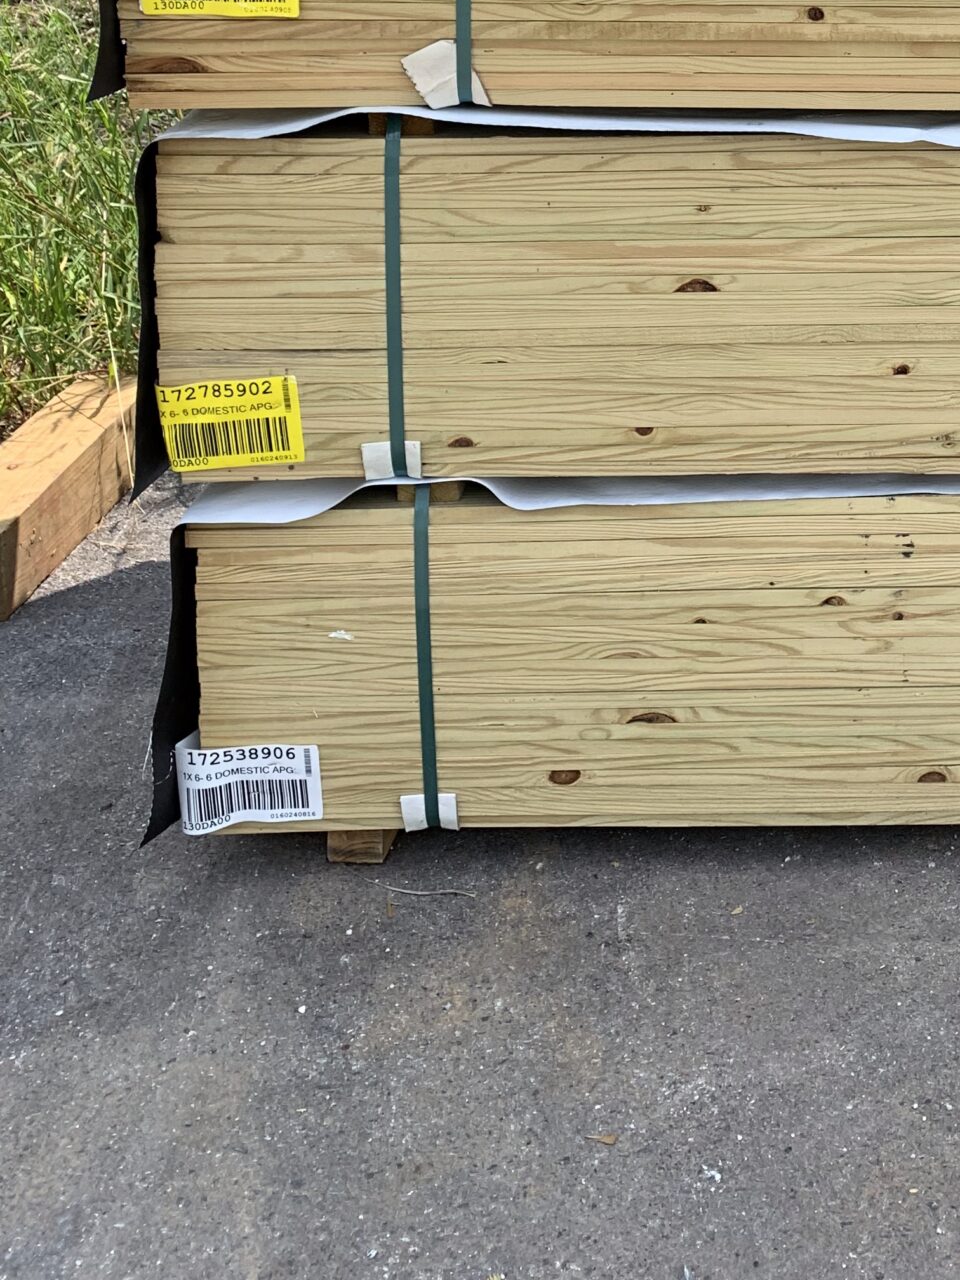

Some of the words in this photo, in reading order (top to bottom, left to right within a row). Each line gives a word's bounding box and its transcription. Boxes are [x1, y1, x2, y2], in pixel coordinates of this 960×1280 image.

[153, 1, 204, 10] 130DA00
[160, 380, 272, 403] 172785902
[160, 410, 166, 418] X
[192, 404, 246, 416] DOMESTIC
[172, 457, 209, 468] 0DA00
[187, 746, 296, 766] 172538906
[183, 772, 192, 781] 1X
[215, 766, 270, 780] DOMESTIC
[183, 814, 232, 831] 130DA00
